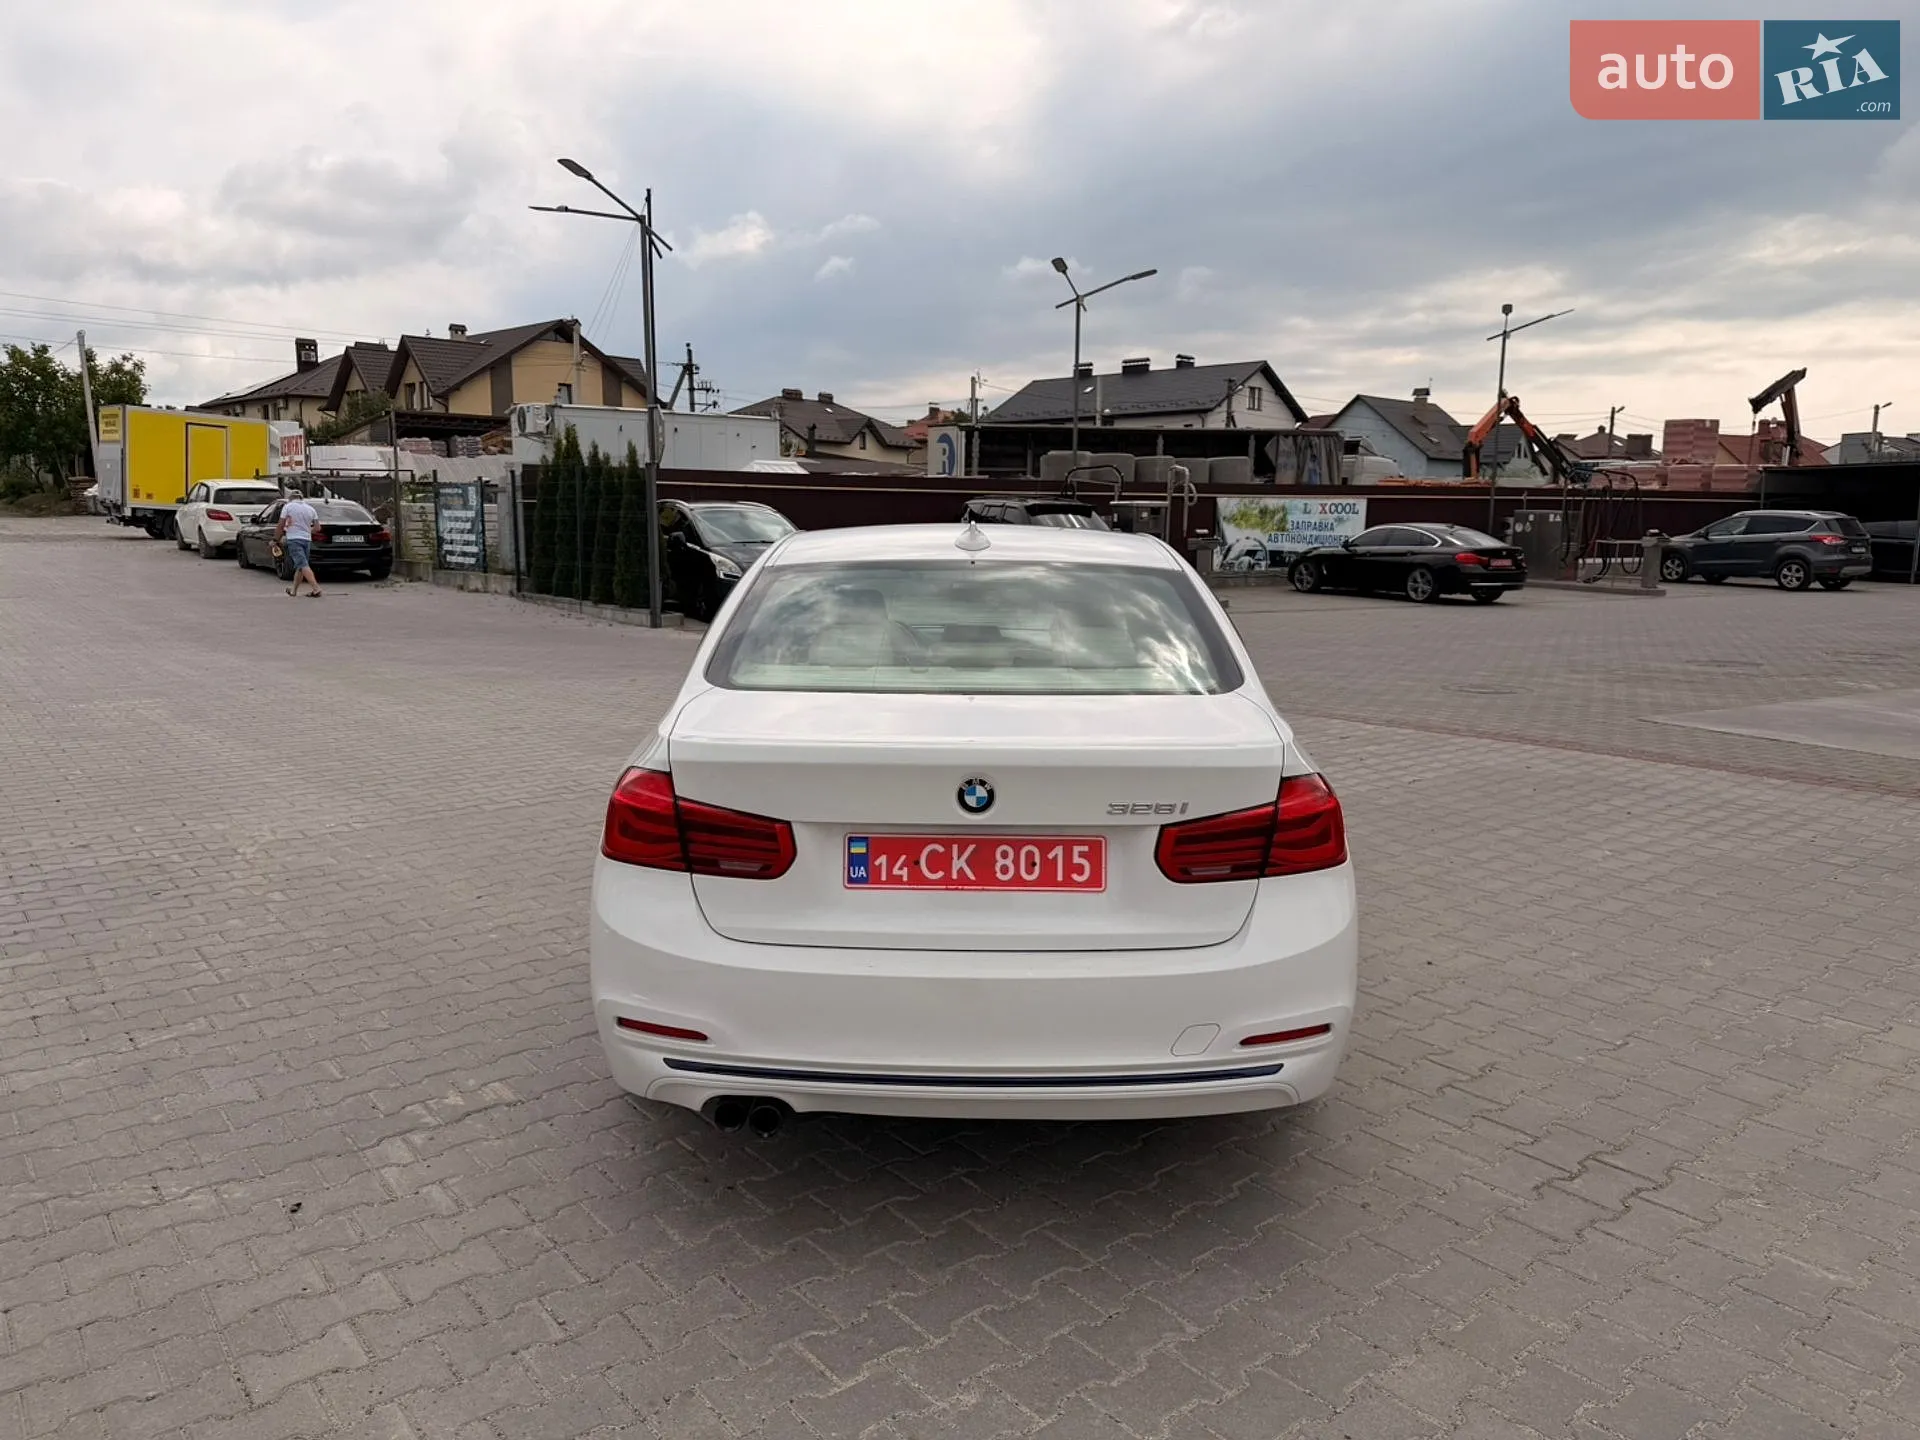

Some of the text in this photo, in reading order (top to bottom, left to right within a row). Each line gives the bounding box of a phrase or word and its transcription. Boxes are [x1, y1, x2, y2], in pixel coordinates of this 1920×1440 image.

[1303, 502, 1360, 515] LXCOOL
[1290, 520, 1335, 532] ЗАПРАВКА
[1106, 801, 1190, 815] 328i
[874, 843, 1092, 883] 14 CK 8015
[850, 866, 867, 879] UA
